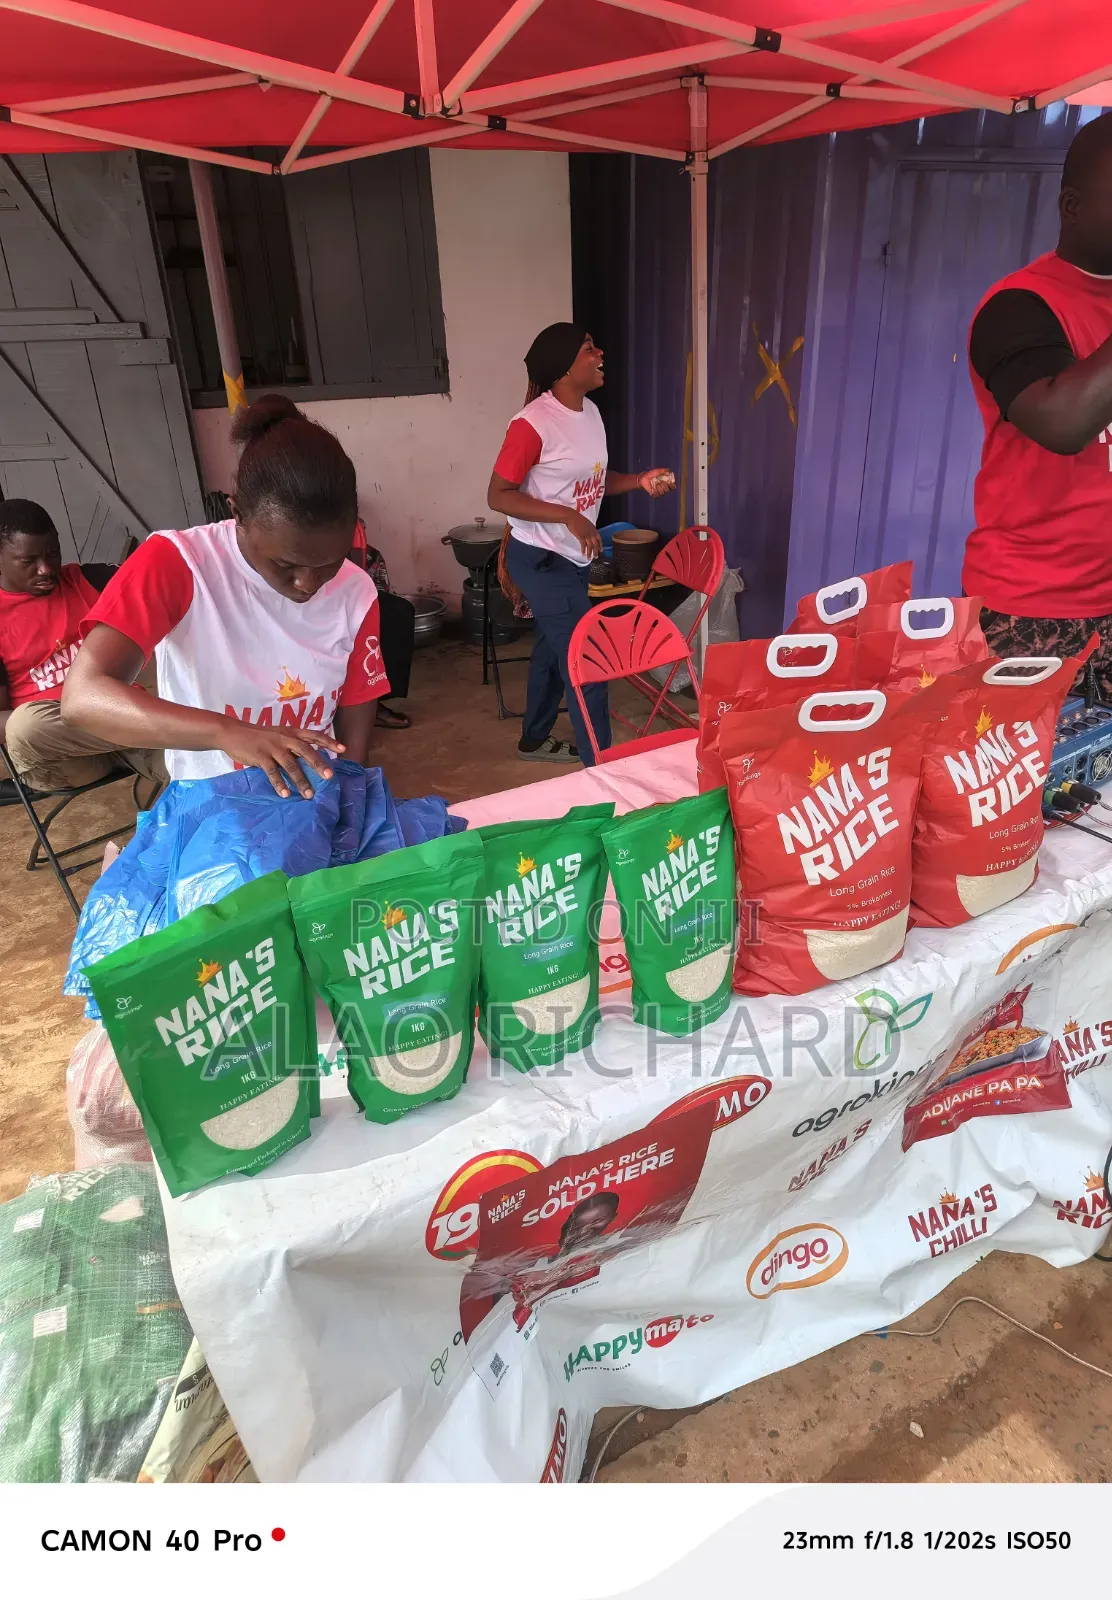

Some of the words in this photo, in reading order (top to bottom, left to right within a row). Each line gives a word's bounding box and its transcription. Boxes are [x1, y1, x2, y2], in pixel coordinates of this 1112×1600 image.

[776, 747, 892, 855] NANA'S
[968, 750, 1048, 828] RICE
[799, 797, 900, 886] RICE
[989, 829, 1009, 839] Long
[1011, 821, 1029, 832] Grain
[641, 825, 721, 901] NANA'S
[829, 885, 855, 897] Long
[857, 874, 879, 889] Grain
[880, 866, 896, 879] Rice
[985, 858, 1018, 872] HAPPY
[485, 853, 582, 924] NANA'S
[653, 859, 719, 923] RICE
[861, 889, 893, 907] Brokenness
[497, 885, 579, 948] RICE
[701, 912, 713, 921] Rice
[343, 899, 459, 977] NANA'S
[523, 951, 540, 960] Long
[541, 946, 559, 956] Grain
[560, 941, 574, 950] Rice
[359, 939, 456, 1000] RICE
[528, 984, 551, 995] HAPPY
[552, 972, 580, 987] EATING!
[546, 964, 559, 976] 1KG
[154, 937, 277, 1047] NANA'S
[387, 1006, 407, 1017] Long
[408, 1002, 429, 1012] Grain
[430, 997, 447, 1006] Rice
[175, 976, 278, 1067] RICE
[411, 1022, 425, 1033] 1KG
[210, 1061, 231, 1075] Long
[232, 1050, 254, 1064] Grain
[255, 1041, 272, 1053] Rice
[388, 1041, 415, 1052] HAPPY
[1053, 1020, 1112, 1066] ANA'S
[240, 1070, 256, 1084] 1KG
[987, 1080, 1013, 1095] PA
[1016, 1075, 1043, 1089] PA
[1065, 1053, 1108, 1085] HILLI
[220, 1091, 249, 1111] HAPPY
[249, 1074, 283, 1096] EATING!
[521, 1181, 597, 1228] SOLD
[603, 1147, 675, 1189] HERE
[548, 1159, 614, 1196] NANA'S
[618, 1142, 658, 1167] RICE
[487, 1189, 526, 1219] NANA'S
[491, 1200, 523, 1224] RICE
[907, 1182, 998, 1243] NANA'S
[928, 1217, 988, 1258] CHILLI
[760, 1237, 829, 1286] dingo
